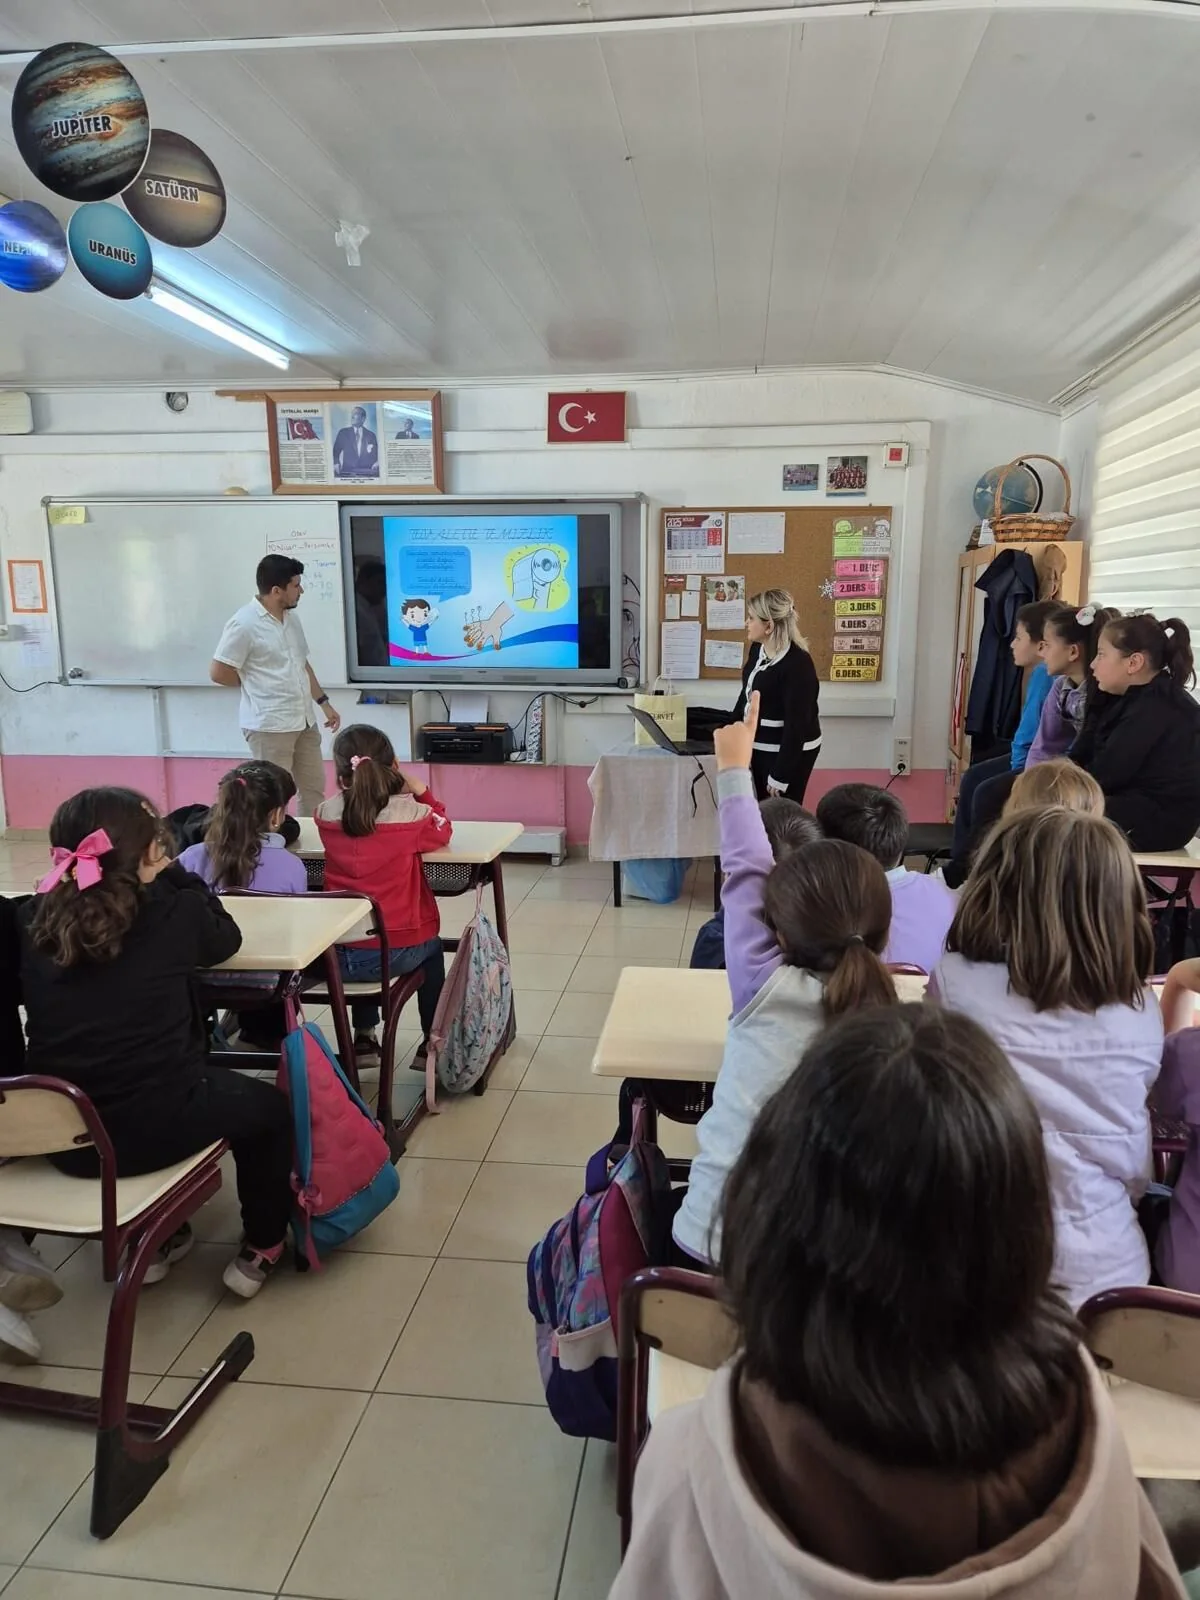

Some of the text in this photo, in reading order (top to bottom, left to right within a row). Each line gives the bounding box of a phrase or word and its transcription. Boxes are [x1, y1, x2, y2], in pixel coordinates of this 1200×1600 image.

[145, 180, 199, 202] SATÜRN
[4, 240, 48, 256] NEP
[89, 239, 137, 265] URANÜS
[840, 583, 866, 592] 2.DERS
[850, 602, 876, 611] 3.DERS
[841, 620, 867, 628] 4.DERS
[856, 657, 876, 666] DERS
[835, 669, 861, 678] 6.DERS
